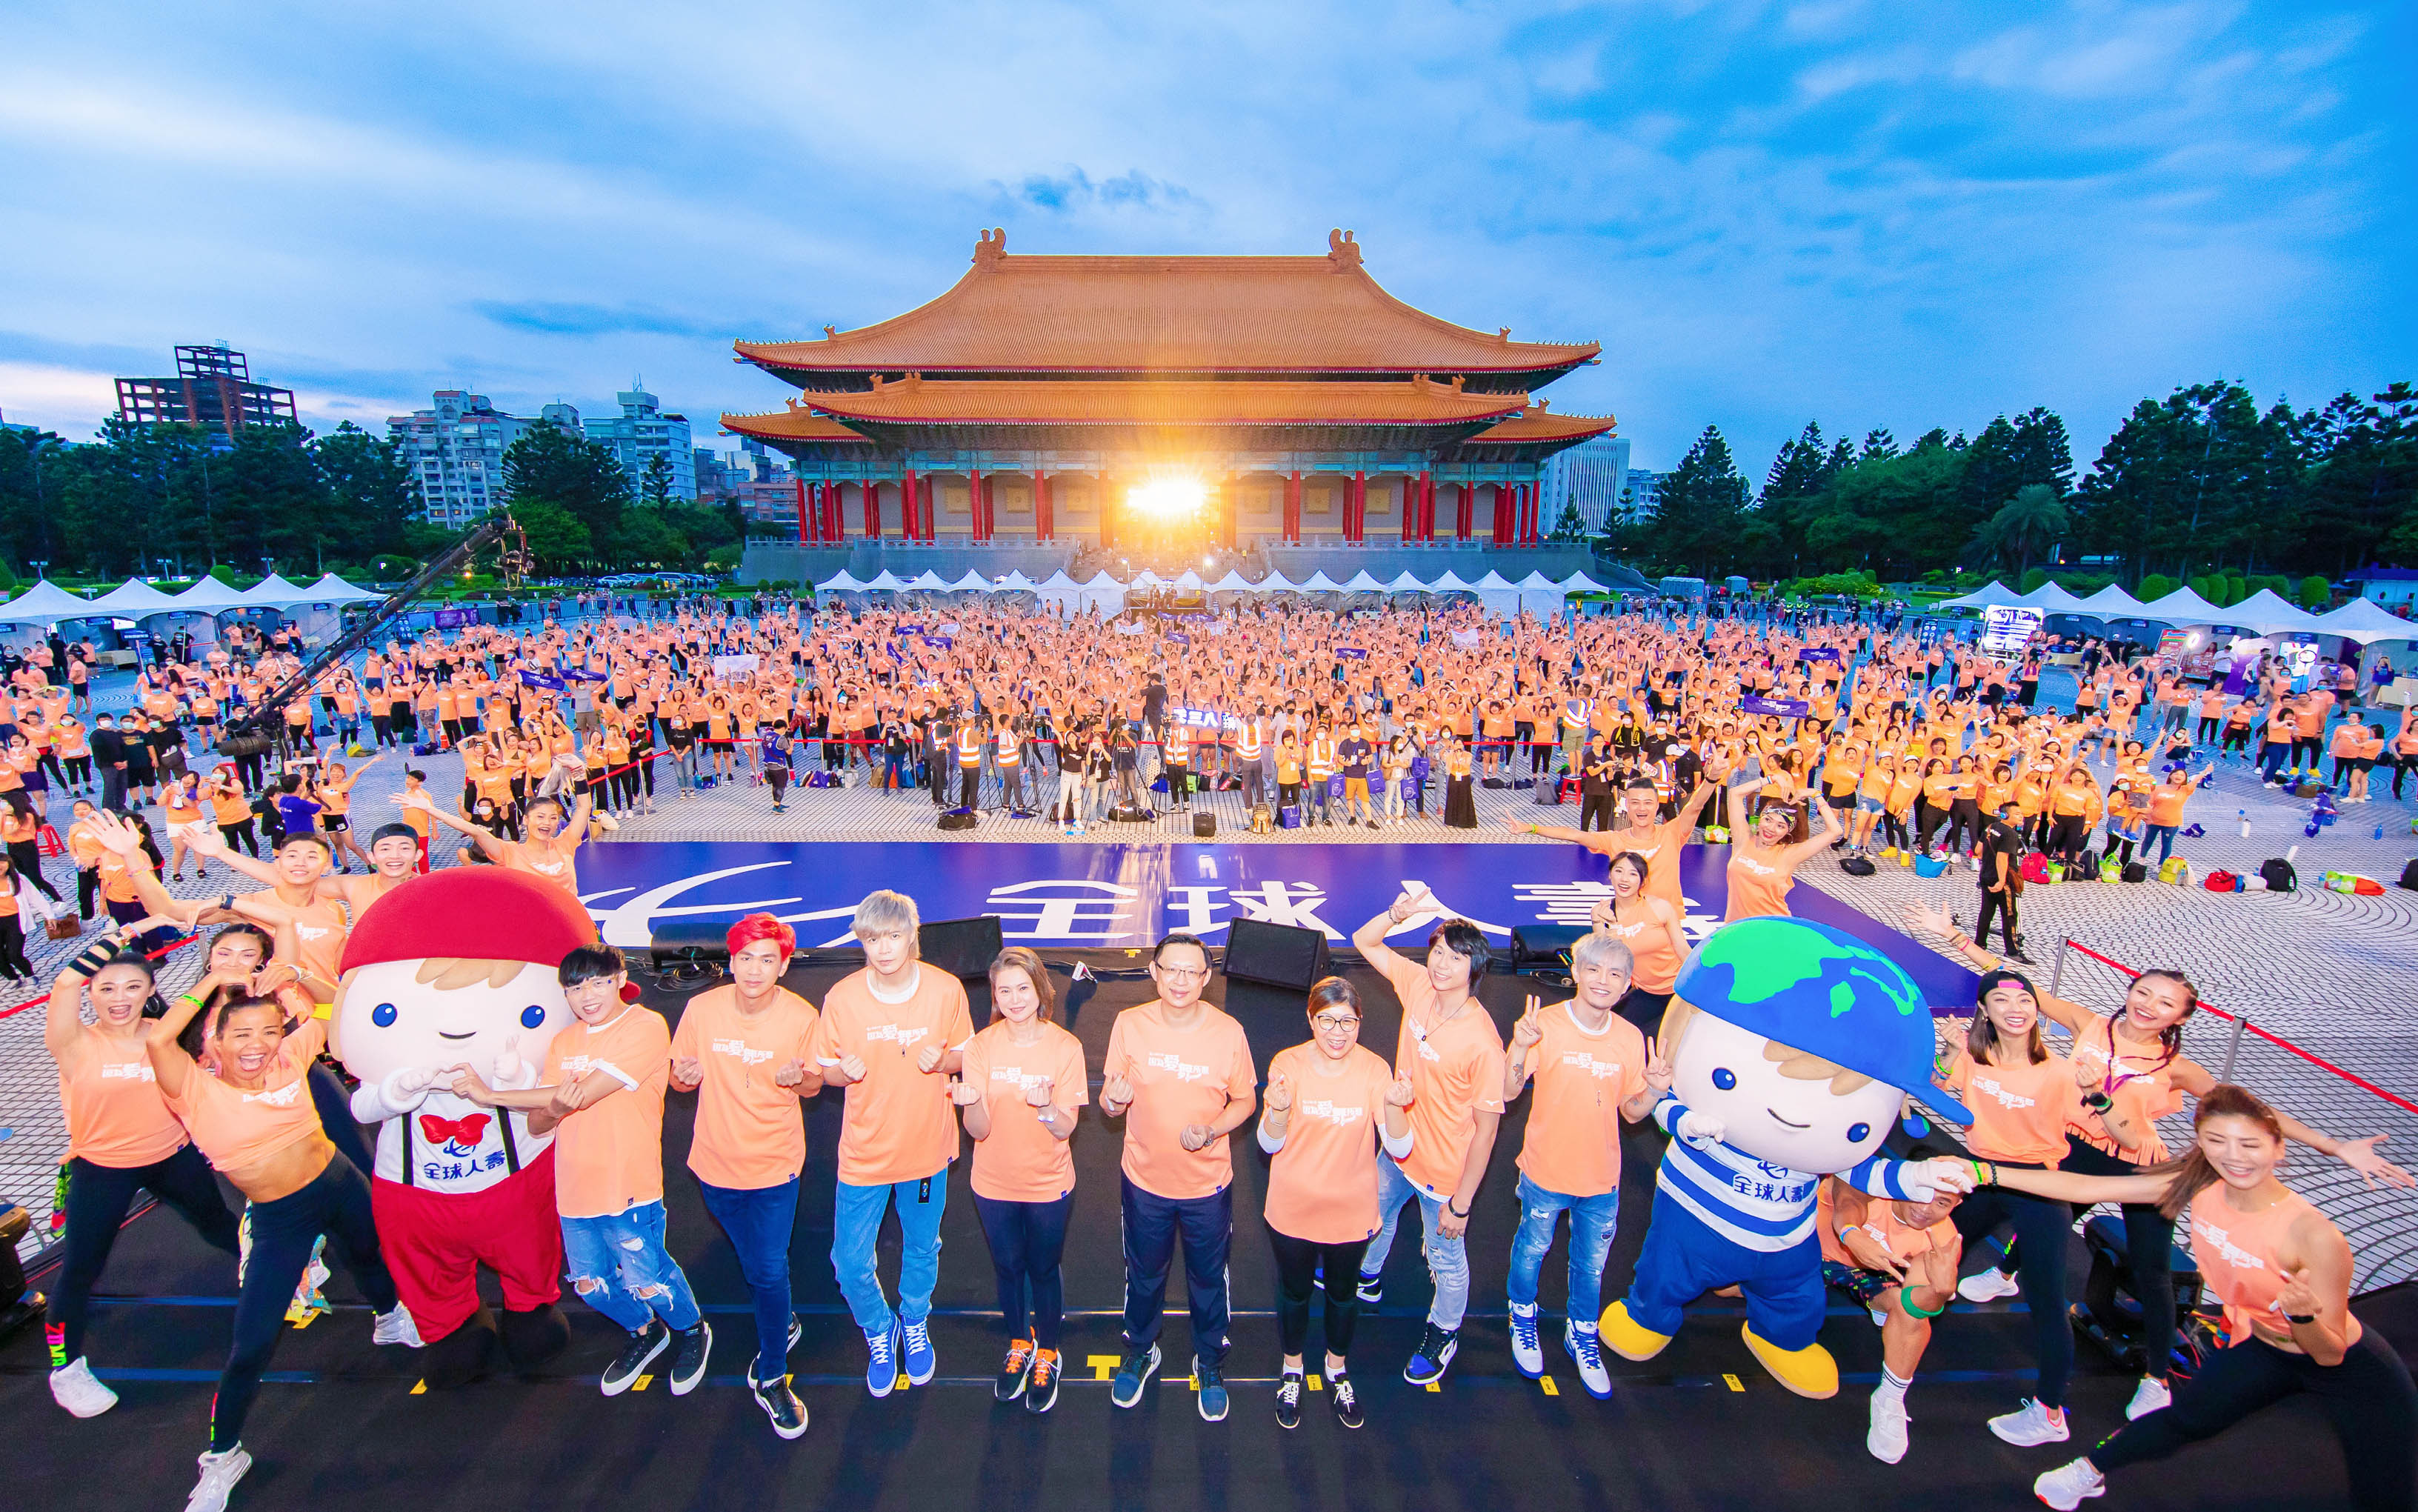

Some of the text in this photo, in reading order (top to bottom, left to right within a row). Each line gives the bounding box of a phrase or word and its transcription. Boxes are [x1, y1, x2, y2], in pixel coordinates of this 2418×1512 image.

[981, 880, 1719, 940] 全球人壽
[424, 1150, 505, 1180] 全球人壽
[1734, 1176, 1802, 1203] 全球人壽
